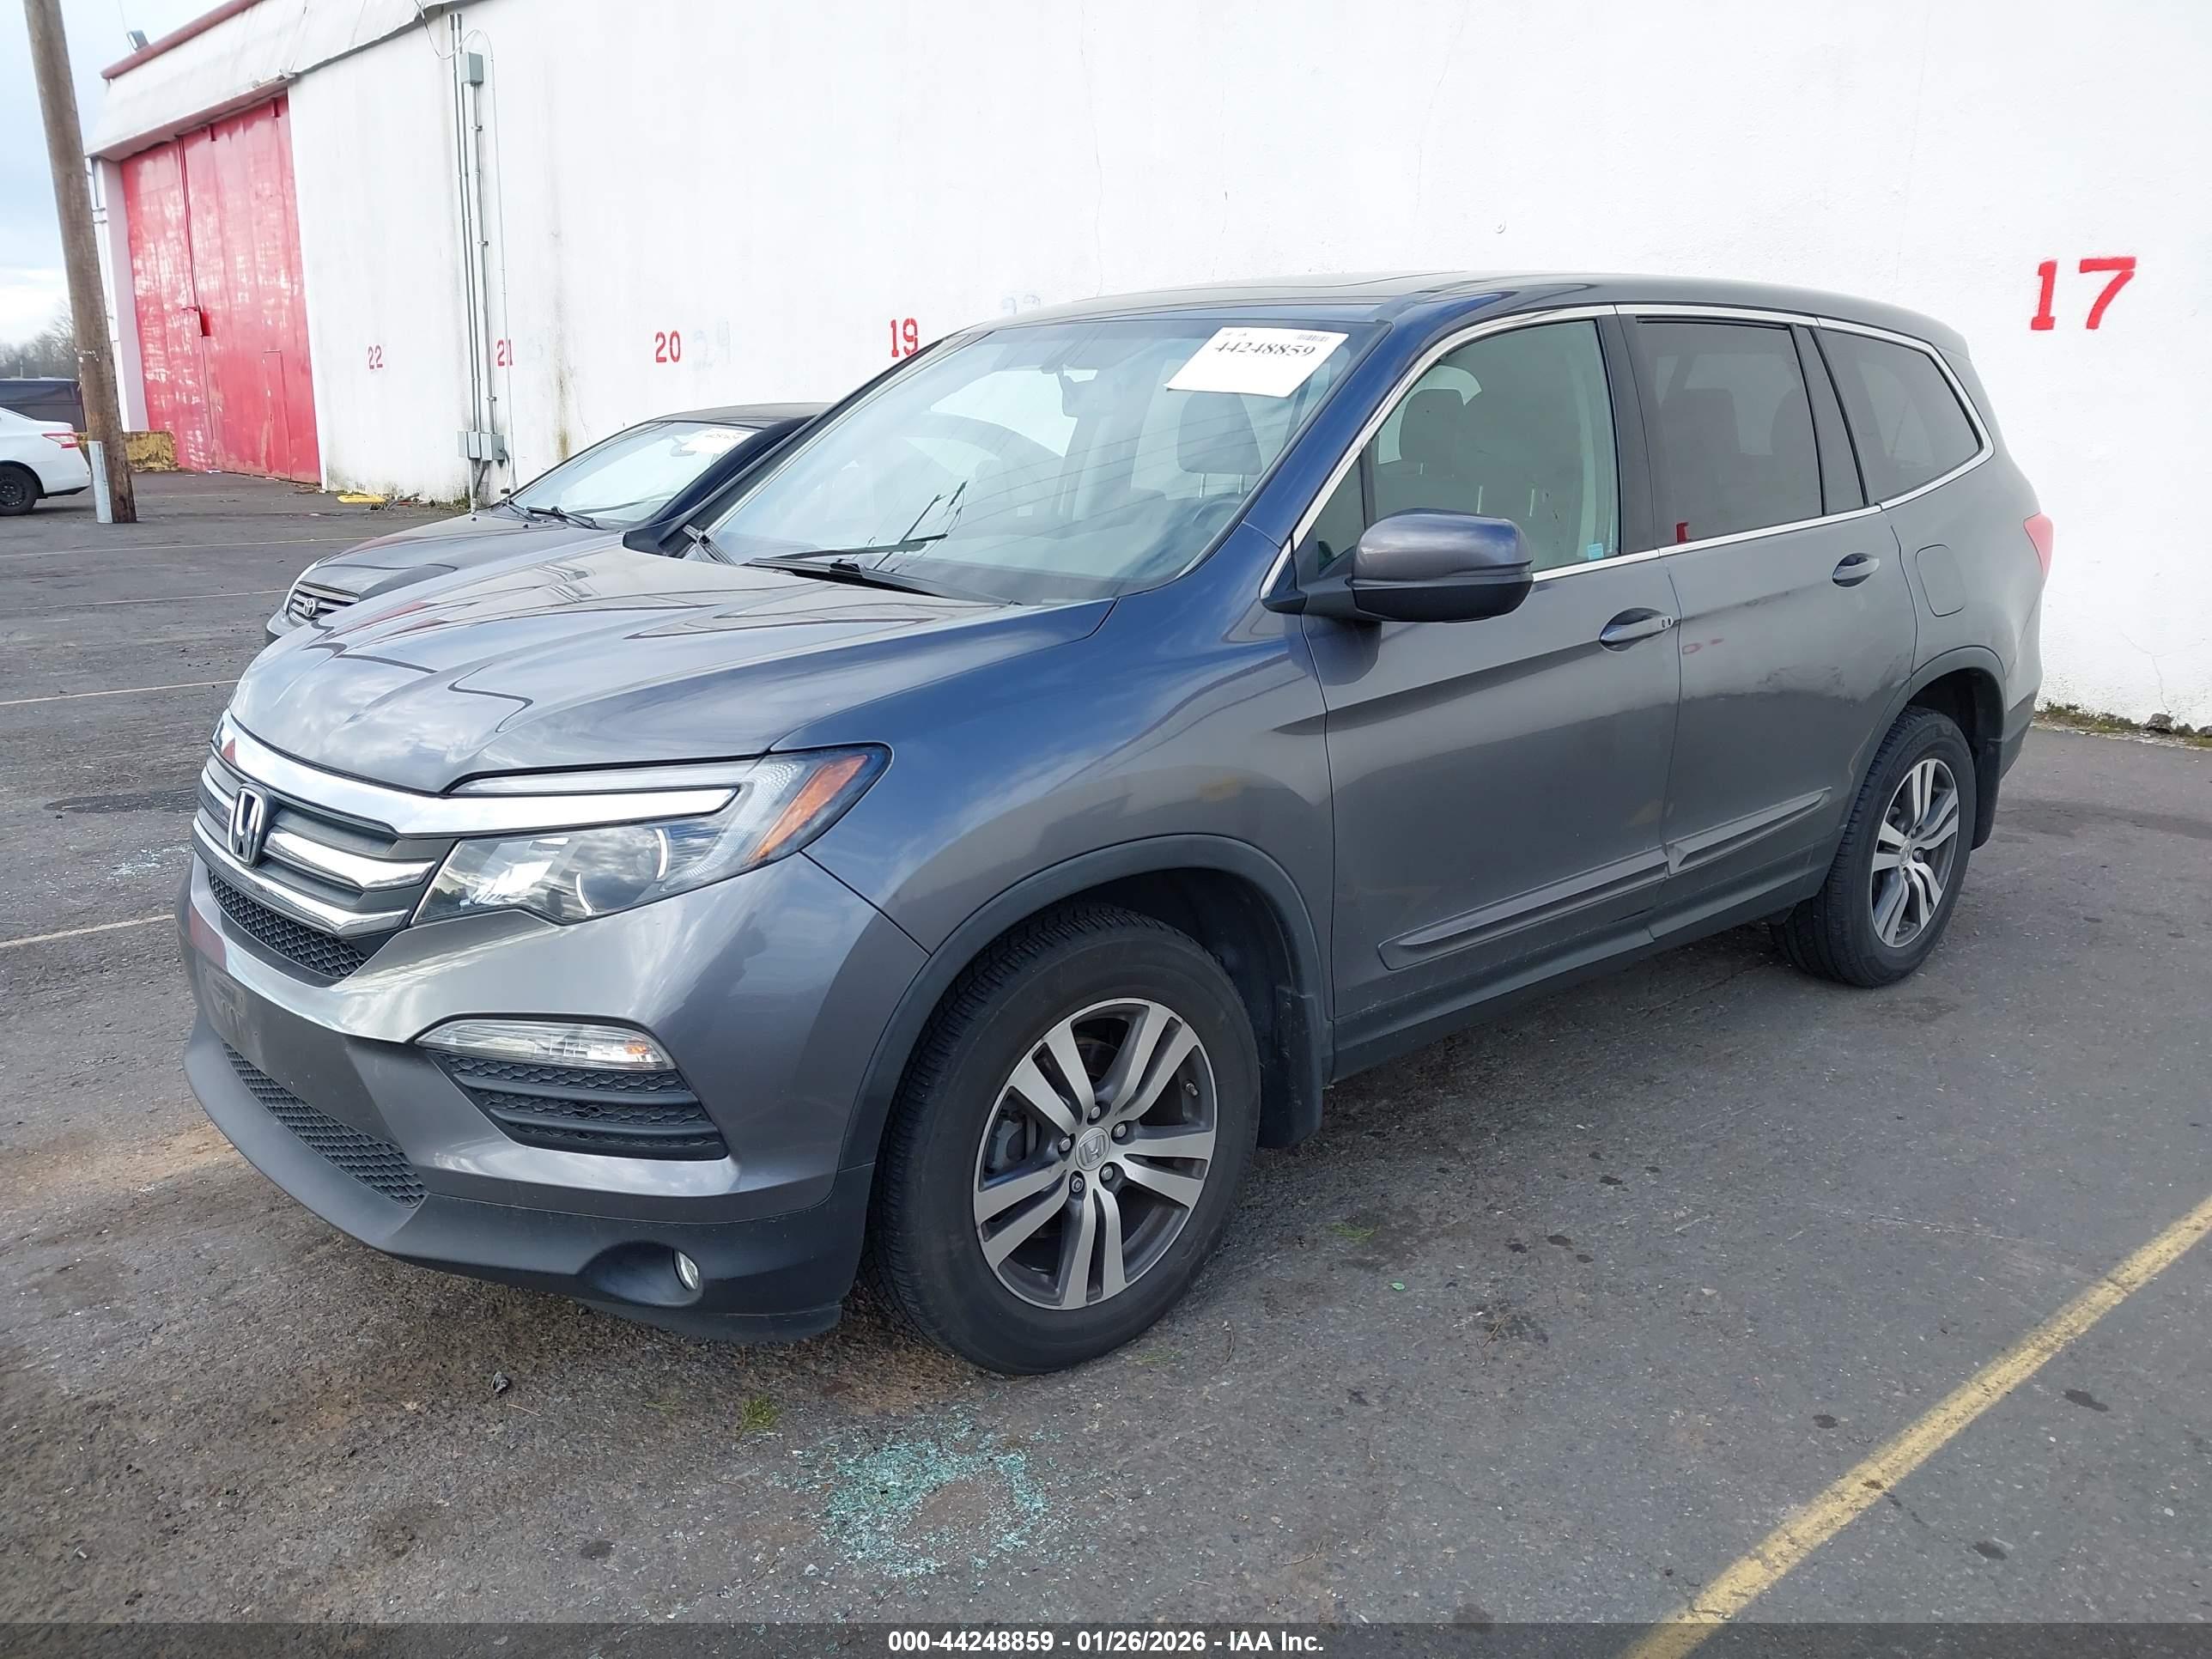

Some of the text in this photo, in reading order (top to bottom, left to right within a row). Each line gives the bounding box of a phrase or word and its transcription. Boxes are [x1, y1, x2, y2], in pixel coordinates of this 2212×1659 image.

[2029, 255, 2137, 331] 17
[496, 338, 514, 367] 21
[654, 330, 681, 363] 20
[889, 318, 920, 358] 19
[1214, 341, 1316, 357] 44248859
[368, 344, 384, 370] 22
